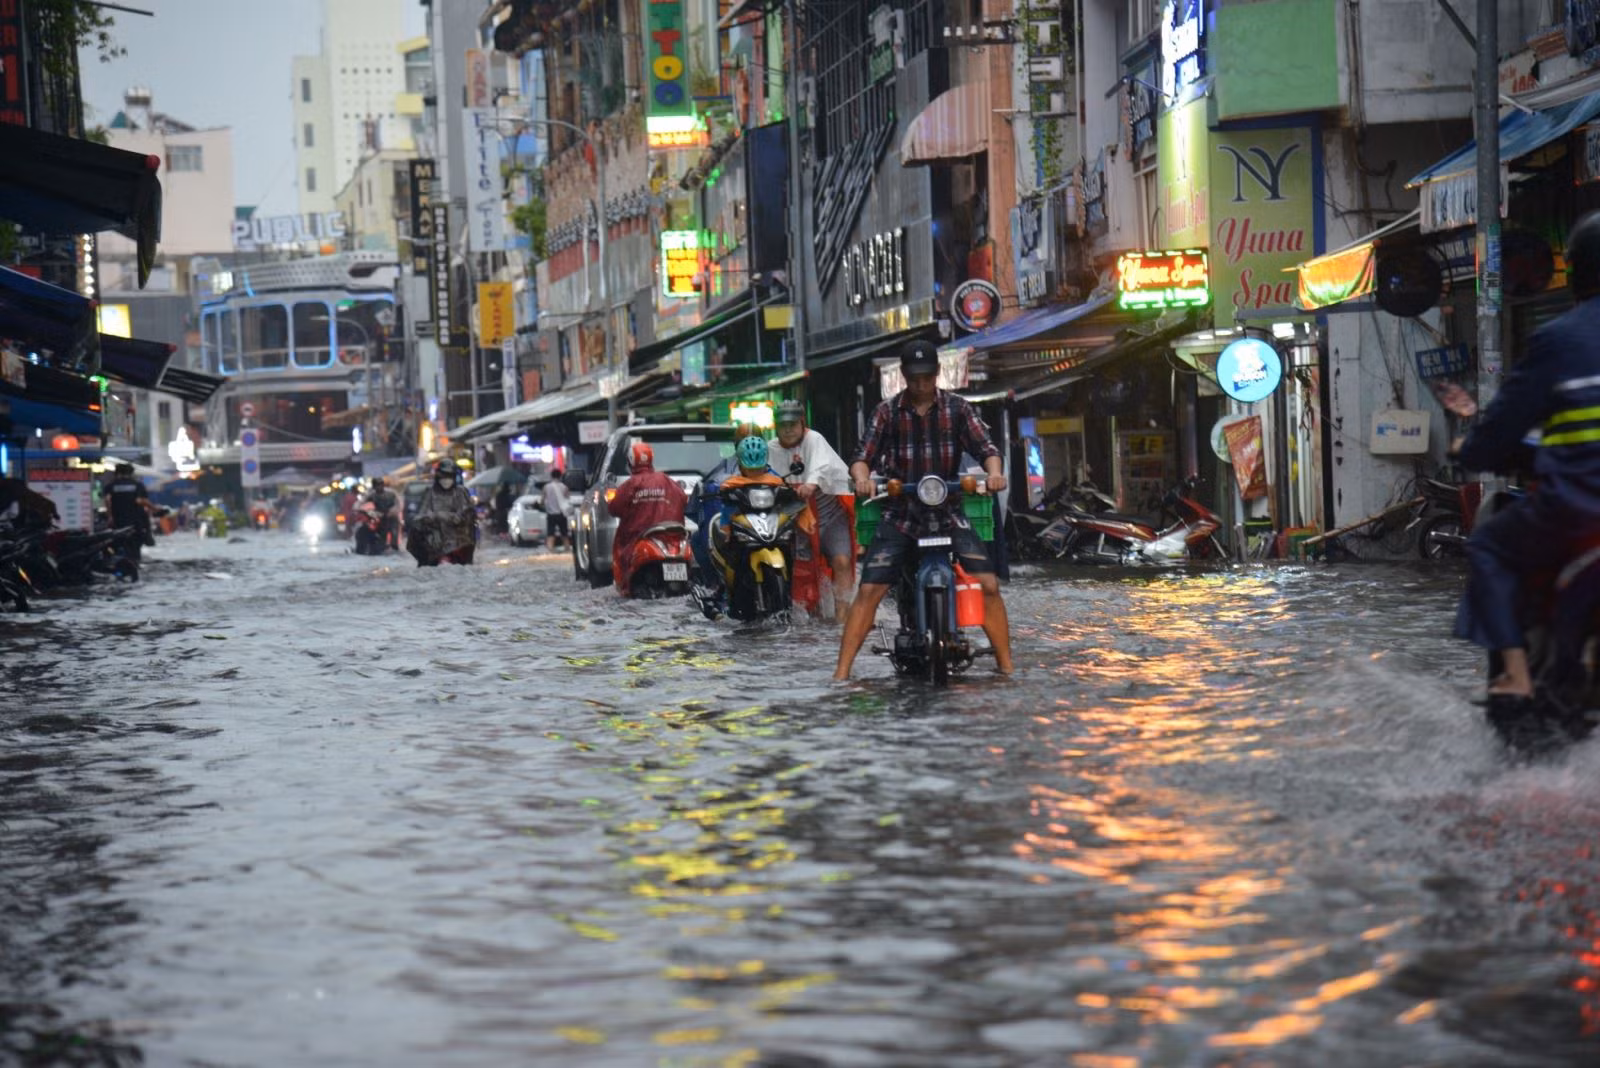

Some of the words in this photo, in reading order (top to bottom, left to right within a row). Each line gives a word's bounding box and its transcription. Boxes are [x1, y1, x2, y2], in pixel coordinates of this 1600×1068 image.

[474, 111, 493, 190] Elite
[1218, 143, 1300, 202] NY
[232, 211, 346, 247] PUBLIC
[1216, 217, 1304, 264] Yuna
[1232, 268, 1293, 310] Spa
